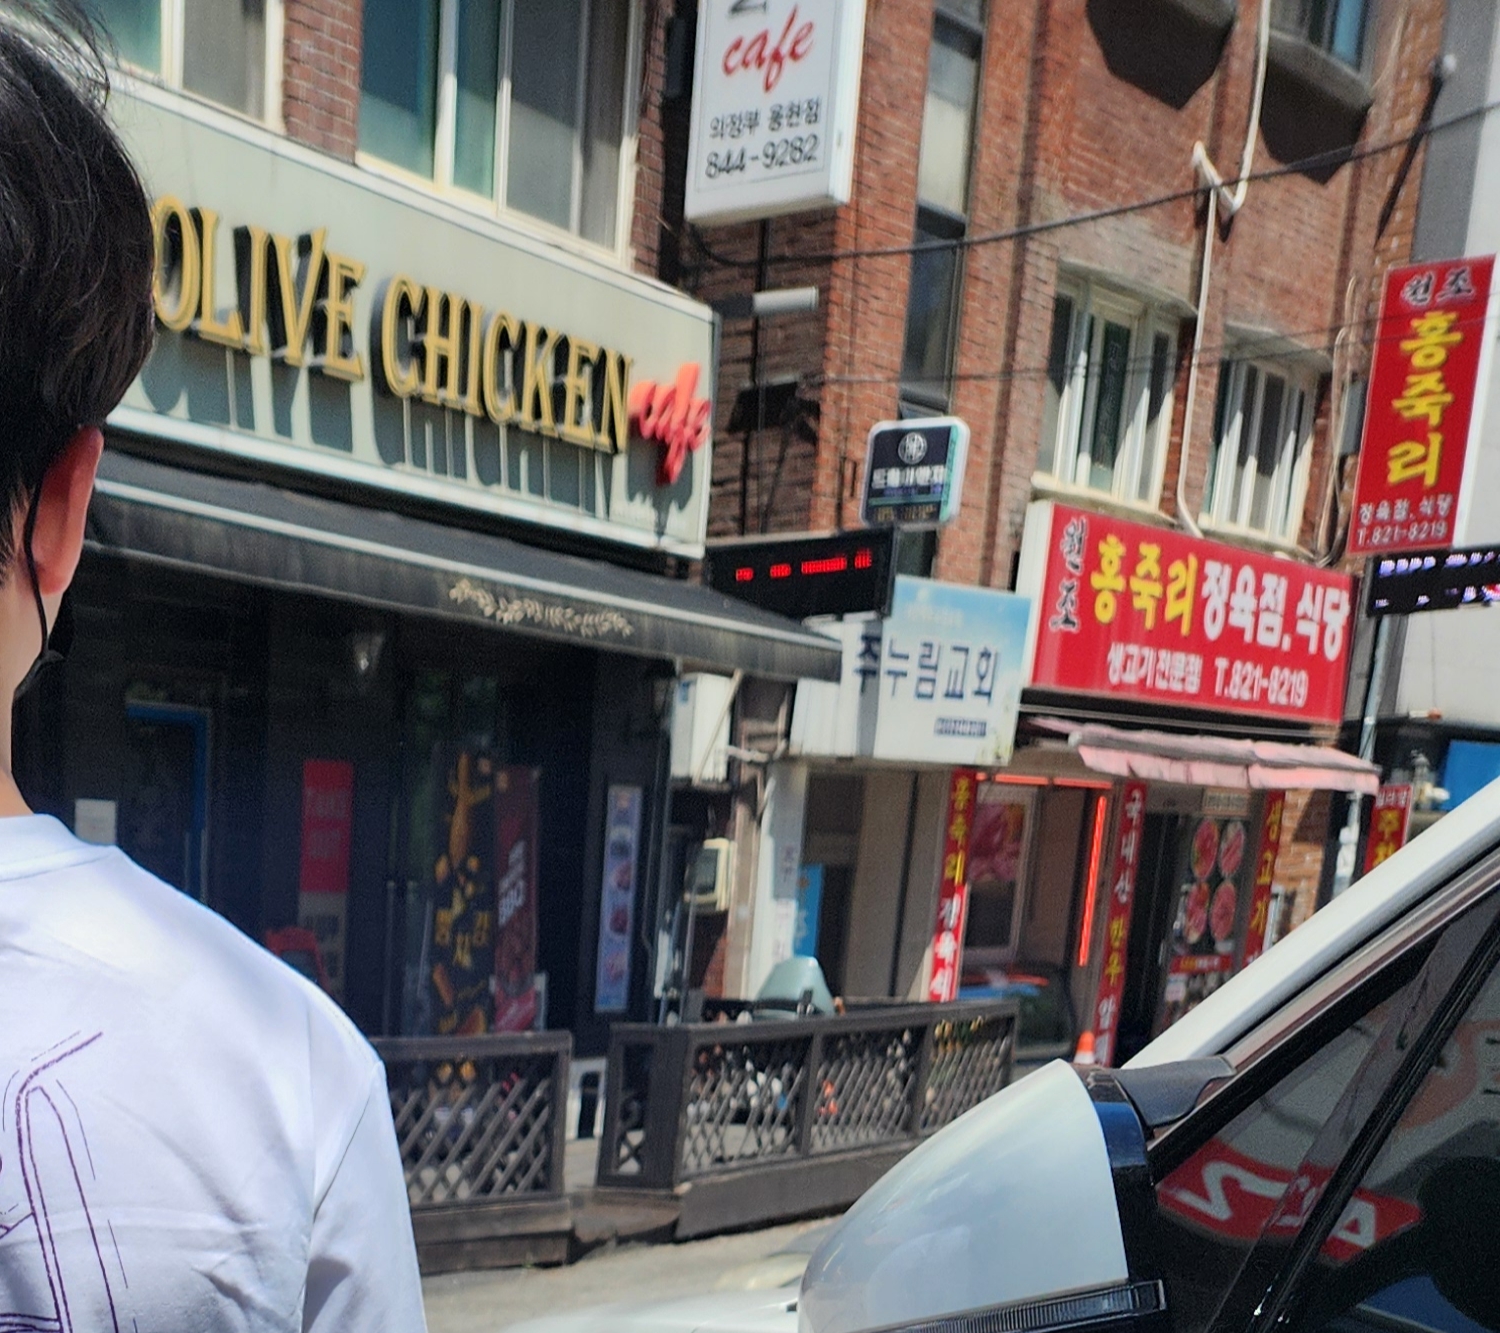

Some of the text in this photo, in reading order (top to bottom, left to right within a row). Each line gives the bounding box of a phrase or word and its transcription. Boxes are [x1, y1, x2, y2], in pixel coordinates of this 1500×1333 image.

[722, 4, 815, 93] cafe
[710, 97, 821, 140] 의정부 용현점
[705, 133, 820, 179] 844-9282
[1400, 267, 1476, 306] 원조
[152, 195, 366, 383] OLIVE
[381, 272, 634, 456] CHICKEN
[1388, 310, 1463, 488] 홍죽리
[1357, 519, 1448, 546] T.821-8219
[1049, 514, 1088, 634] 원조
[1090, 533, 1198, 638] 홍죽리
[854, 633, 998, 707] 주누림교회
[1214, 655, 1309, 708] T.821-8219
[1251, 799, 1284, 939] 생고기
